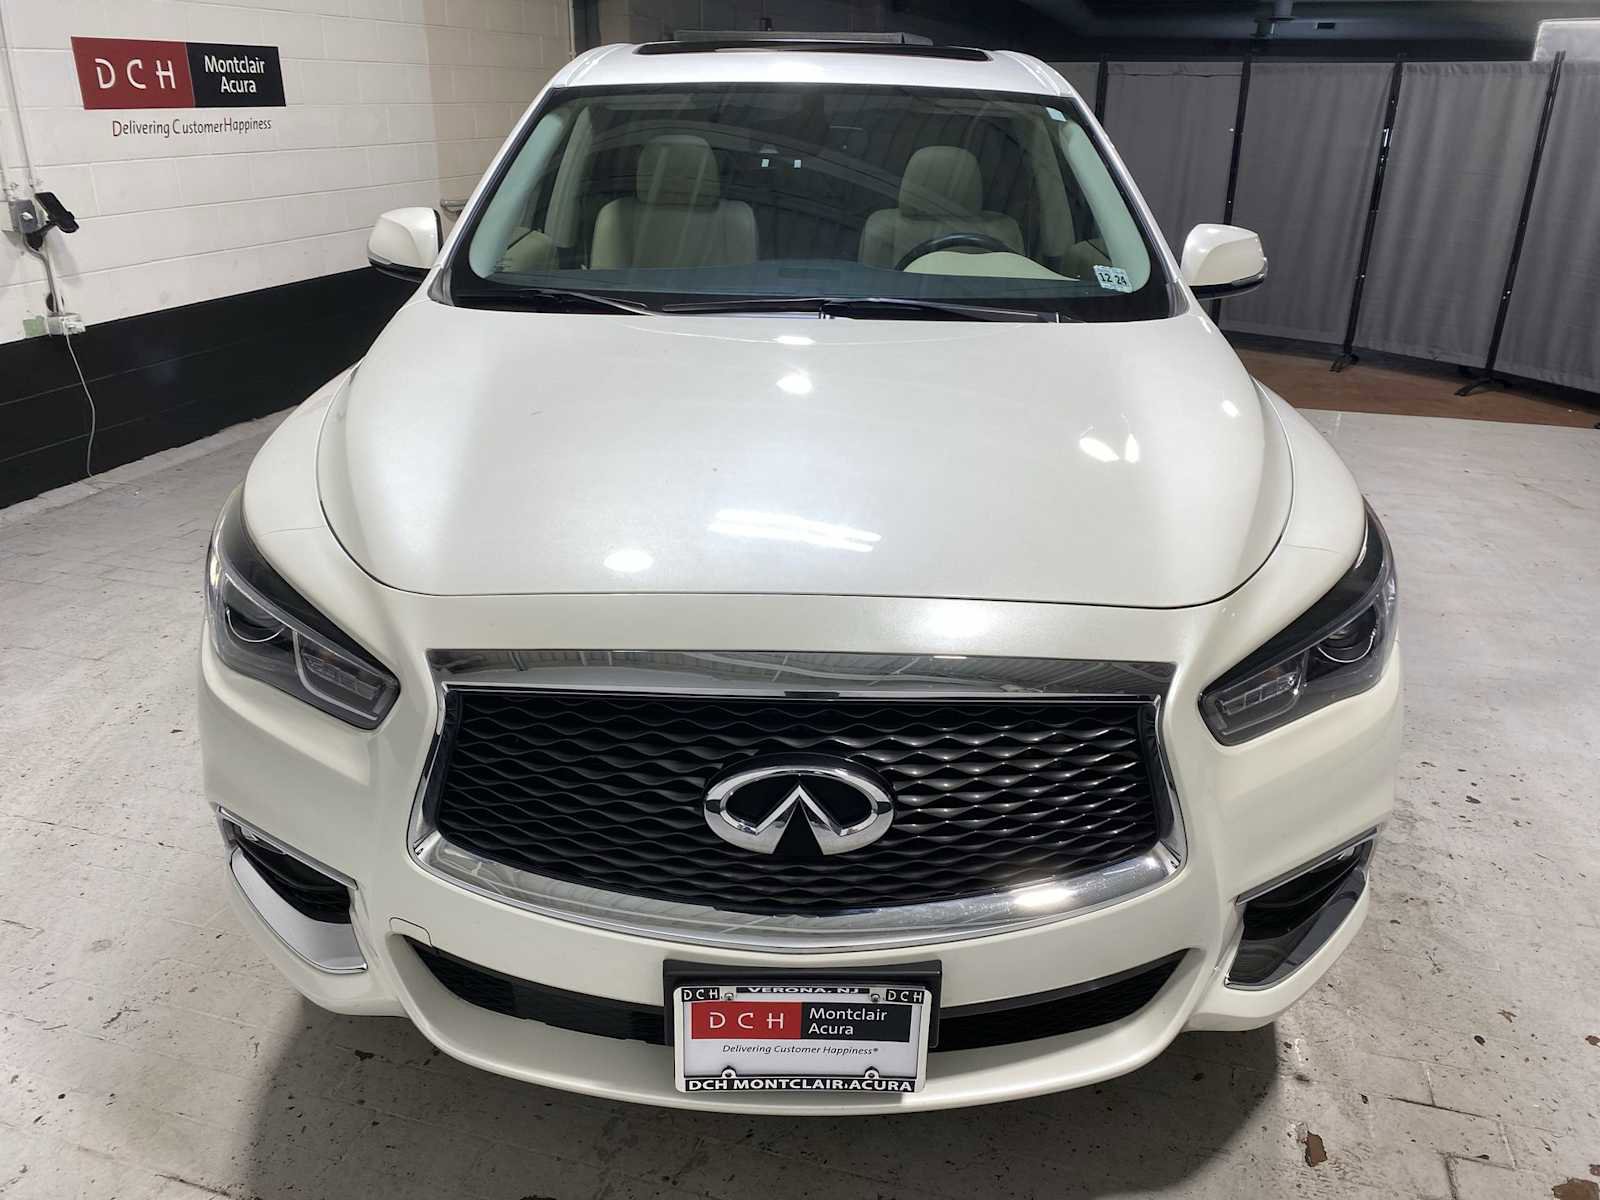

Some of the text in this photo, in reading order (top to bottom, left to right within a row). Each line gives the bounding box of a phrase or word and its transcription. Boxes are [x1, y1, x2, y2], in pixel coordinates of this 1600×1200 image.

[204, 55, 265, 74] Montclair
[220, 76, 257, 93] Acura
[112, 120, 170, 138] Delivering
[1098, 272, 1113, 283] 12
[683, 989, 718, 1001] DCH
[887, 990, 923, 1003] DCH
[709, 1012, 784, 1029] DCH
[809, 1007, 888, 1021] Montclair
[808, 1022, 854, 1035] Acura
[722, 1044, 772, 1055] Delivering
[773, 1045, 821, 1054] Customer
[688, 1079, 913, 1092] DCH MONTCLAIR ACURA
